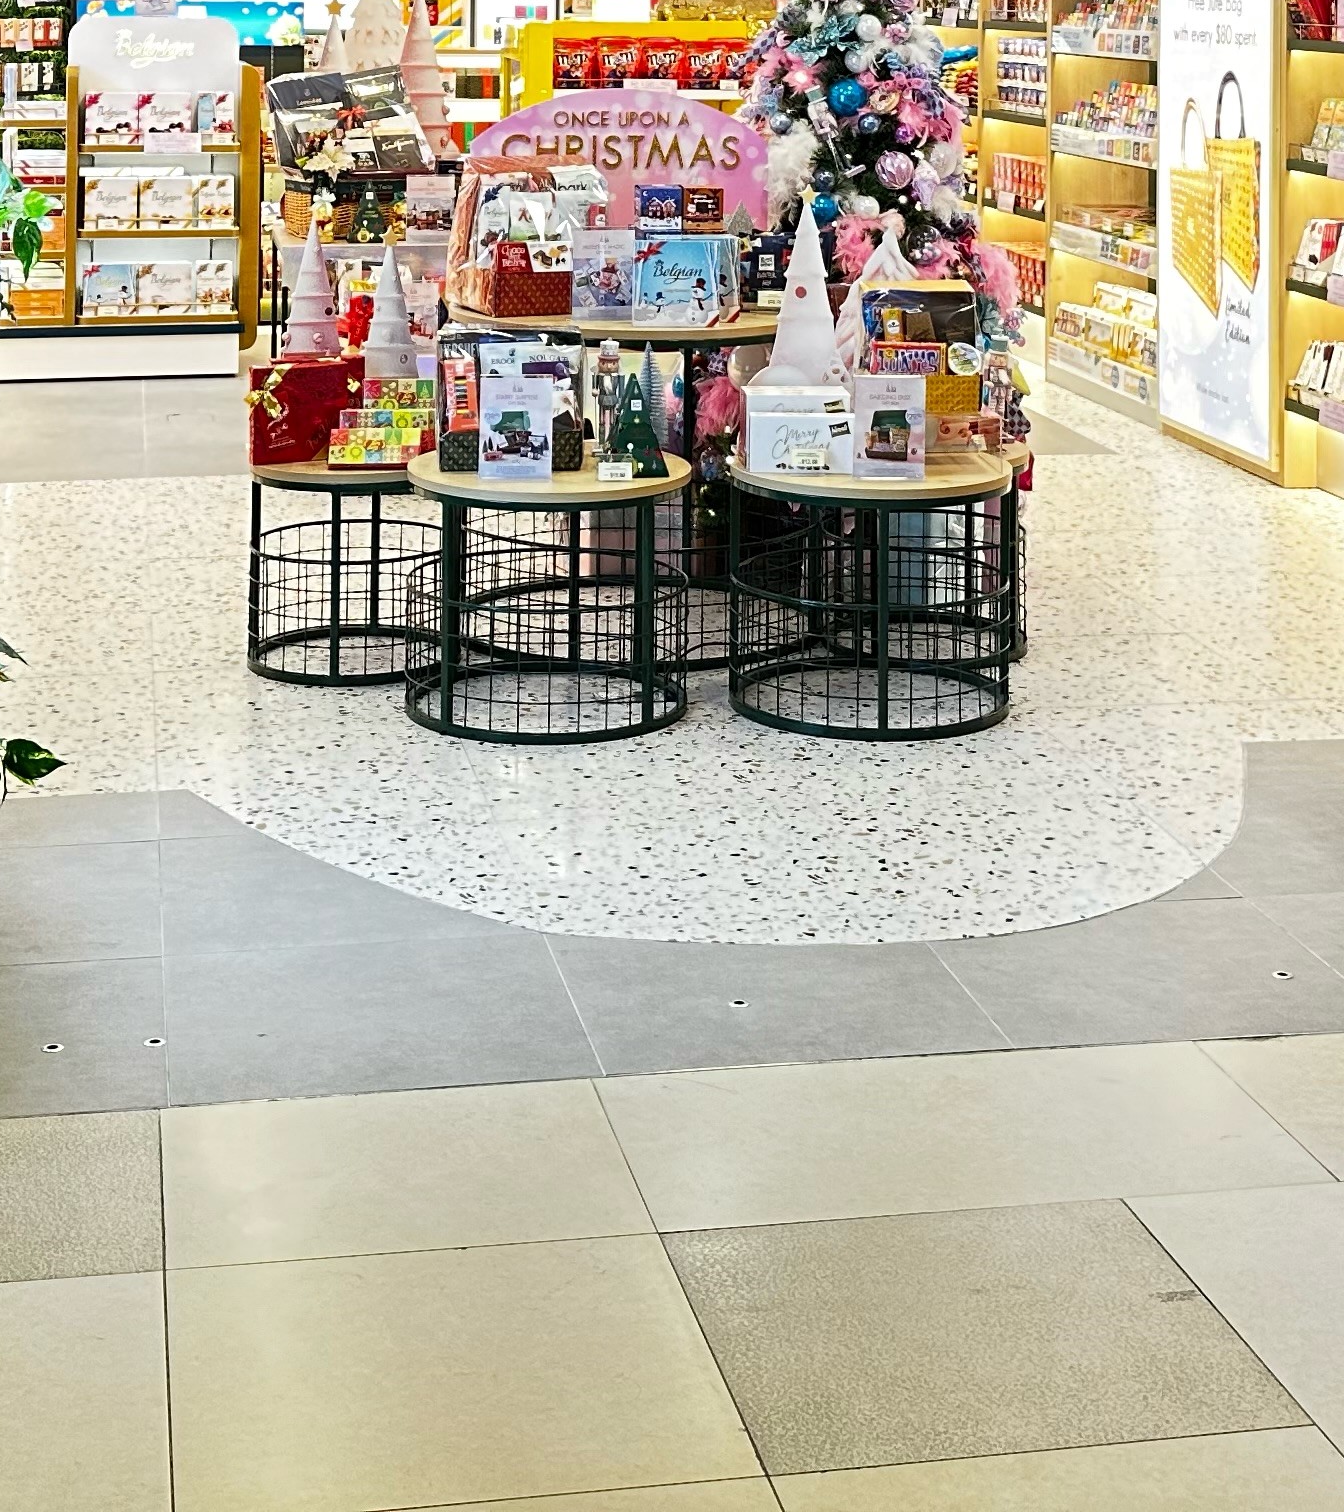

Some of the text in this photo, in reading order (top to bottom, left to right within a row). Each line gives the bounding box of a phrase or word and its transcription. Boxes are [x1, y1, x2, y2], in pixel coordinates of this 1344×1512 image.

[1173, 25, 1189, 42] with
[1191, 29, 1213, 48] every
[1215, 24, 1233, 45] $80
[553, 110, 690, 129] ONCE UPON A
[501, 133, 741, 170] CHRISTMAS
[653, 259, 702, 284] Belgian
[775, 424, 820, 445] Merry
